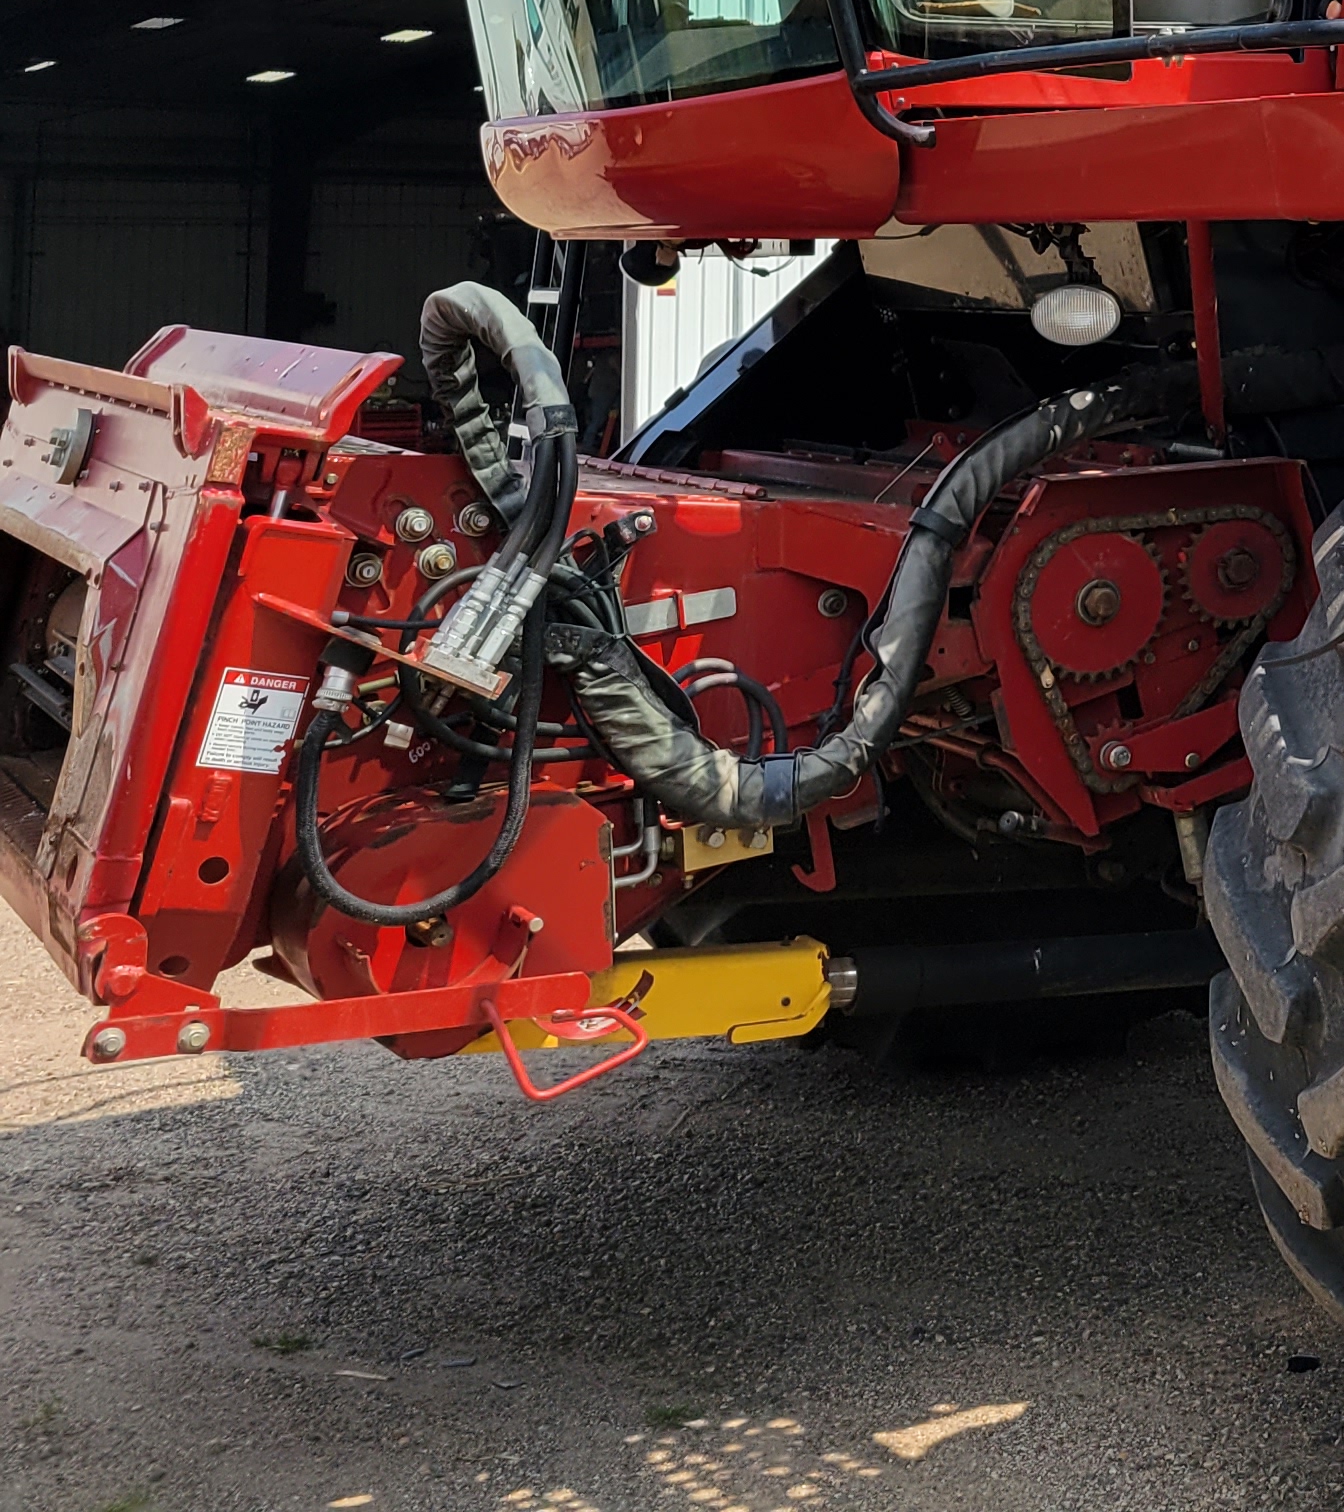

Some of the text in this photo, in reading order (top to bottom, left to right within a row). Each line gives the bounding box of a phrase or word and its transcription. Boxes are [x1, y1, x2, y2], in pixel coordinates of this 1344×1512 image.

[250, 676, 297, 690] DANGER
[217, 715, 290, 729] PINCH POINT HAZARD
